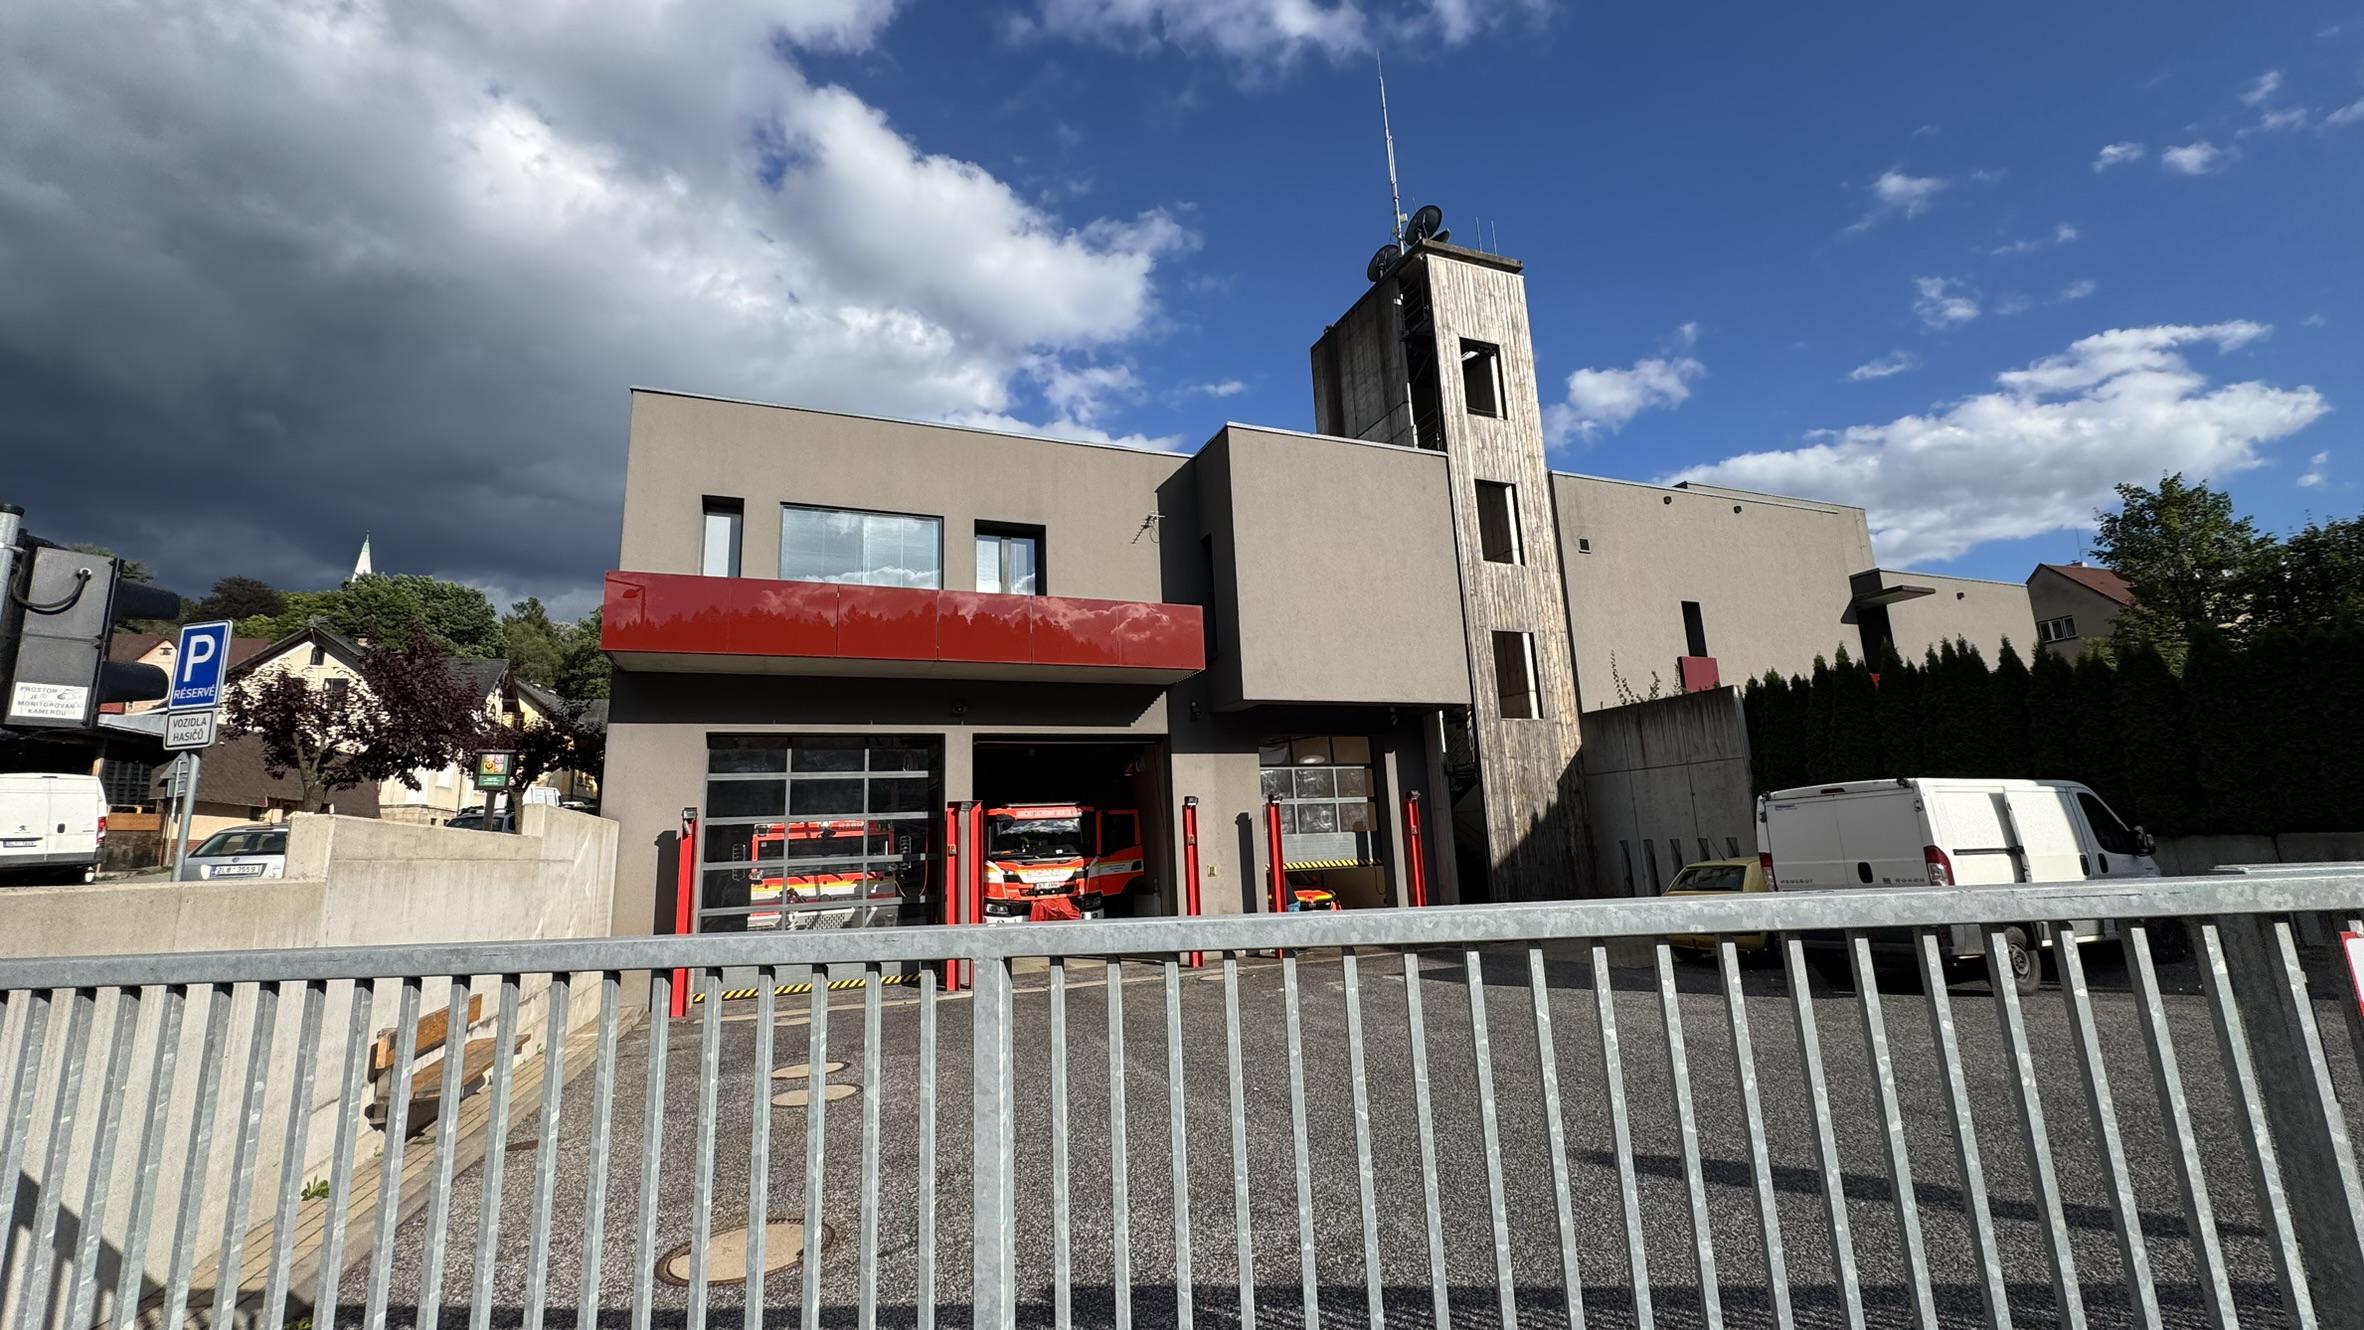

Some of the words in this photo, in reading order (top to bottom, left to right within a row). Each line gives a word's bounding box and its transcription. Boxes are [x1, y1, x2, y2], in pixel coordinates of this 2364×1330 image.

[183, 634, 216, 682] P
[173, 685, 216, 699] RÉSERVÉ
[173, 717, 207, 728] VOZIDLA
[173, 728, 204, 742] HASIČŮ
